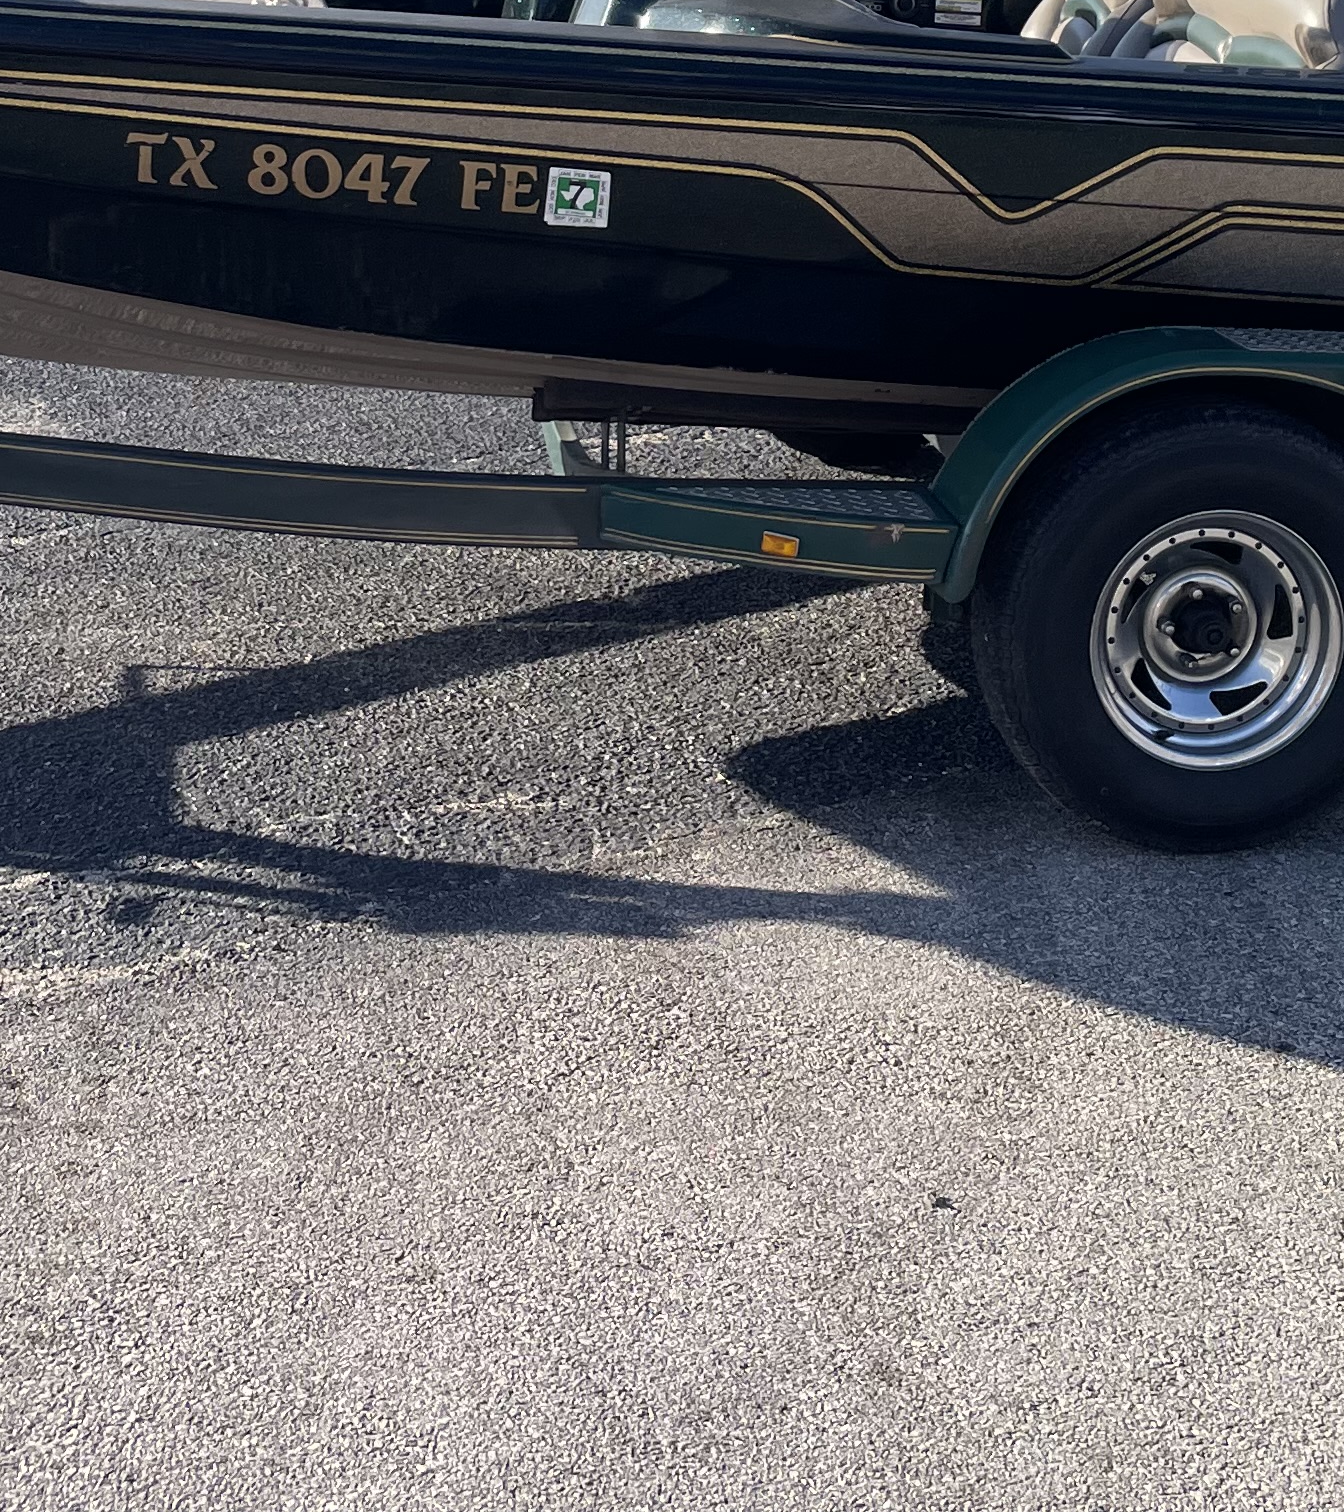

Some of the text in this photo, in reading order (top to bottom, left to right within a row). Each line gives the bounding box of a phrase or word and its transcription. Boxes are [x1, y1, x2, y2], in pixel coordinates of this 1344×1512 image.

[126, 132, 541, 215] TX 8047 FE
[570, 180, 586, 209] 7
